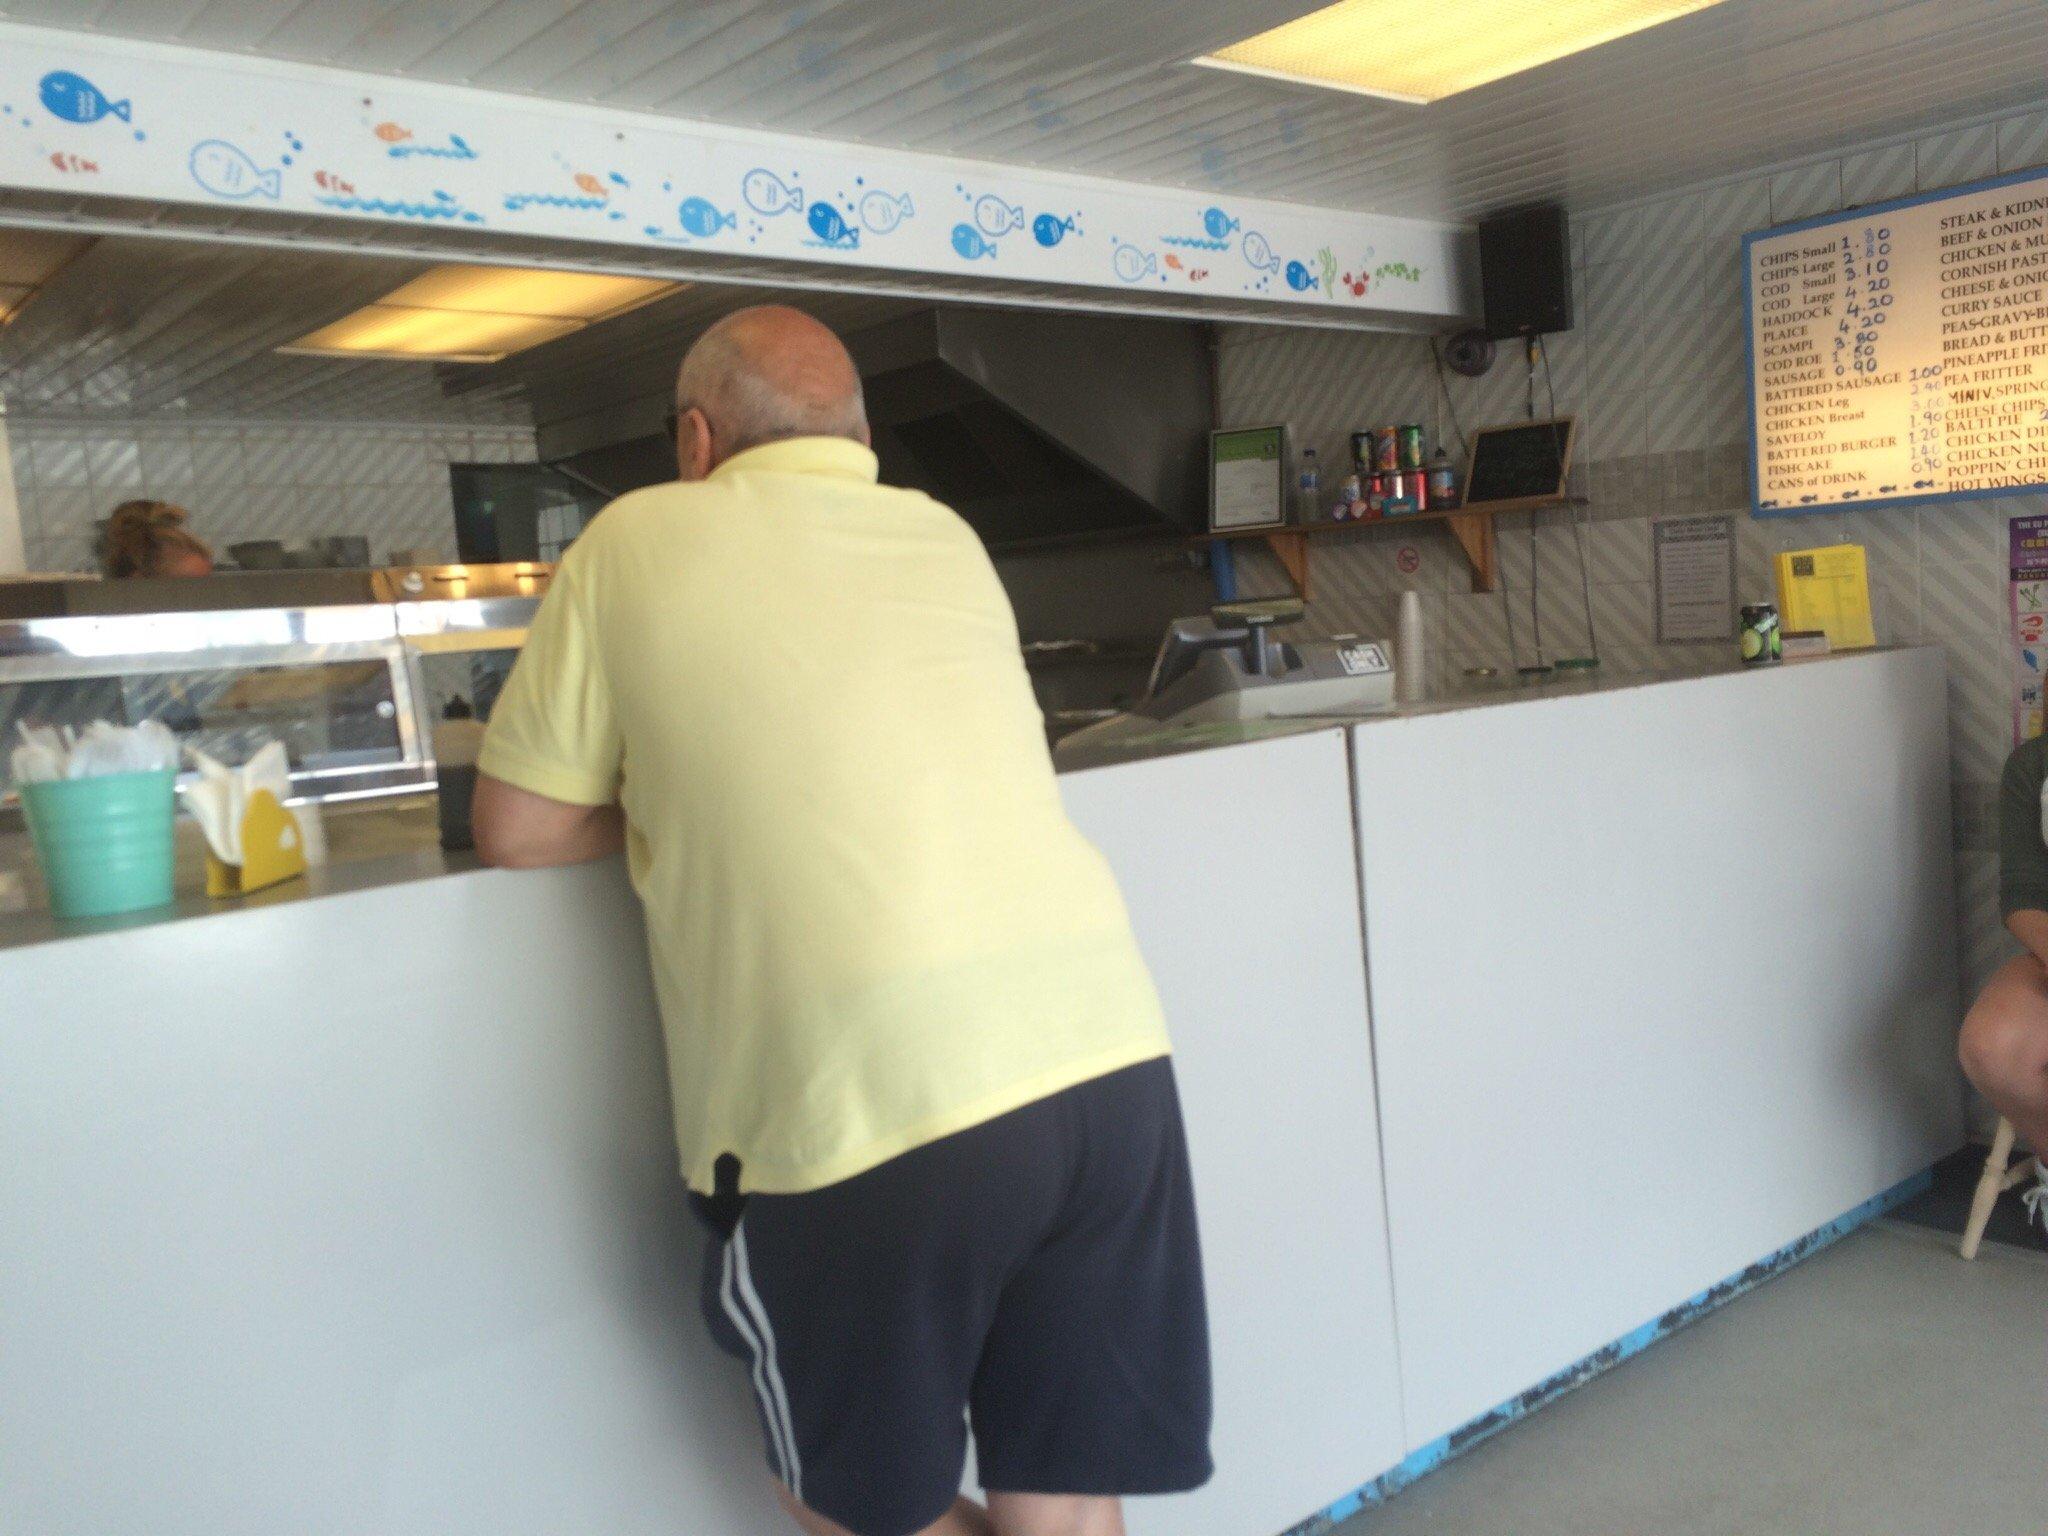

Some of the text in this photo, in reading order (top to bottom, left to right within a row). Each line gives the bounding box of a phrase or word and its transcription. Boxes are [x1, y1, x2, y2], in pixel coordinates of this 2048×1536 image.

[1941, 210, 1986, 230] STEAK
[1990, 208, 2001, 219] &
[1941, 216, 2043, 247] BEEF & ONION
[1761, 250, 1799, 267] CHIPS
[1802, 242, 1836, 258] Small
[1941, 242, 2006, 264] CHICKEN
[2011, 240, 2021, 251] &
[1761, 265, 1799, 282] CHIPS
[1803, 260, 1835, 276] Large
[1941, 260, 2006, 282] CORNISH
[1761, 283, 1790, 297] COD
[1802, 273, 1836, 290] Small
[1941, 280, 1995, 300] CHEESE
[1999, 278, 2010, 289] &
[1762, 298, 1791, 312] COD
[1803, 291, 1835, 307] Large
[1942, 289, 2042, 317] CURRY SAUCE
[1762, 306, 1832, 328] HADDOCK
[1763, 325, 1809, 342] PLAICE
[1943, 333, 1990, 352] BREAD
[1994, 332, 2005, 344] &
[1763, 340, 1813, 357] SCAMPI
[1944, 348, 2020, 369] PINEAPPLE
[1764, 359, 1792, 372] COD
[1796, 354, 1822, 368] ROE
[1764, 369, 1824, 387] SAUSAGE
[1944, 364, 2032, 387] PEA FRITTER
[1765, 382, 1832, 402] BATTERED
[1836, 372, 1902, 391] SAUSAGE
[1765, 401, 1824, 417] CHICKEN
[1829, 398, 1850, 410] Leg
[1945, 399, 2045, 421] CHEESE CHIPS
[1766, 415, 1825, 432] CHICKEN
[1830, 411, 1865, 423] Breast
[1946, 417, 1992, 433] BALTI
[1998, 414, 2022, 427] PIE
[1766, 430, 1827, 447] SAVELOY
[1767, 443, 1837, 461] BATTERED
[1842, 436, 1896, 452] BURGER
[1947, 430, 2020, 448] CHICKEN
[1947, 445, 2021, 463] CHICKEN
[1768, 460, 1832, 476] FISHCAKE
[1948, 460, 2011, 477] POPPIN'
[1768, 478, 1804, 490] CANS
[1808, 475, 1818, 486] of
[1823, 471, 1867, 486] DRINK
[1949, 473, 2046, 493] HOT WINGS
